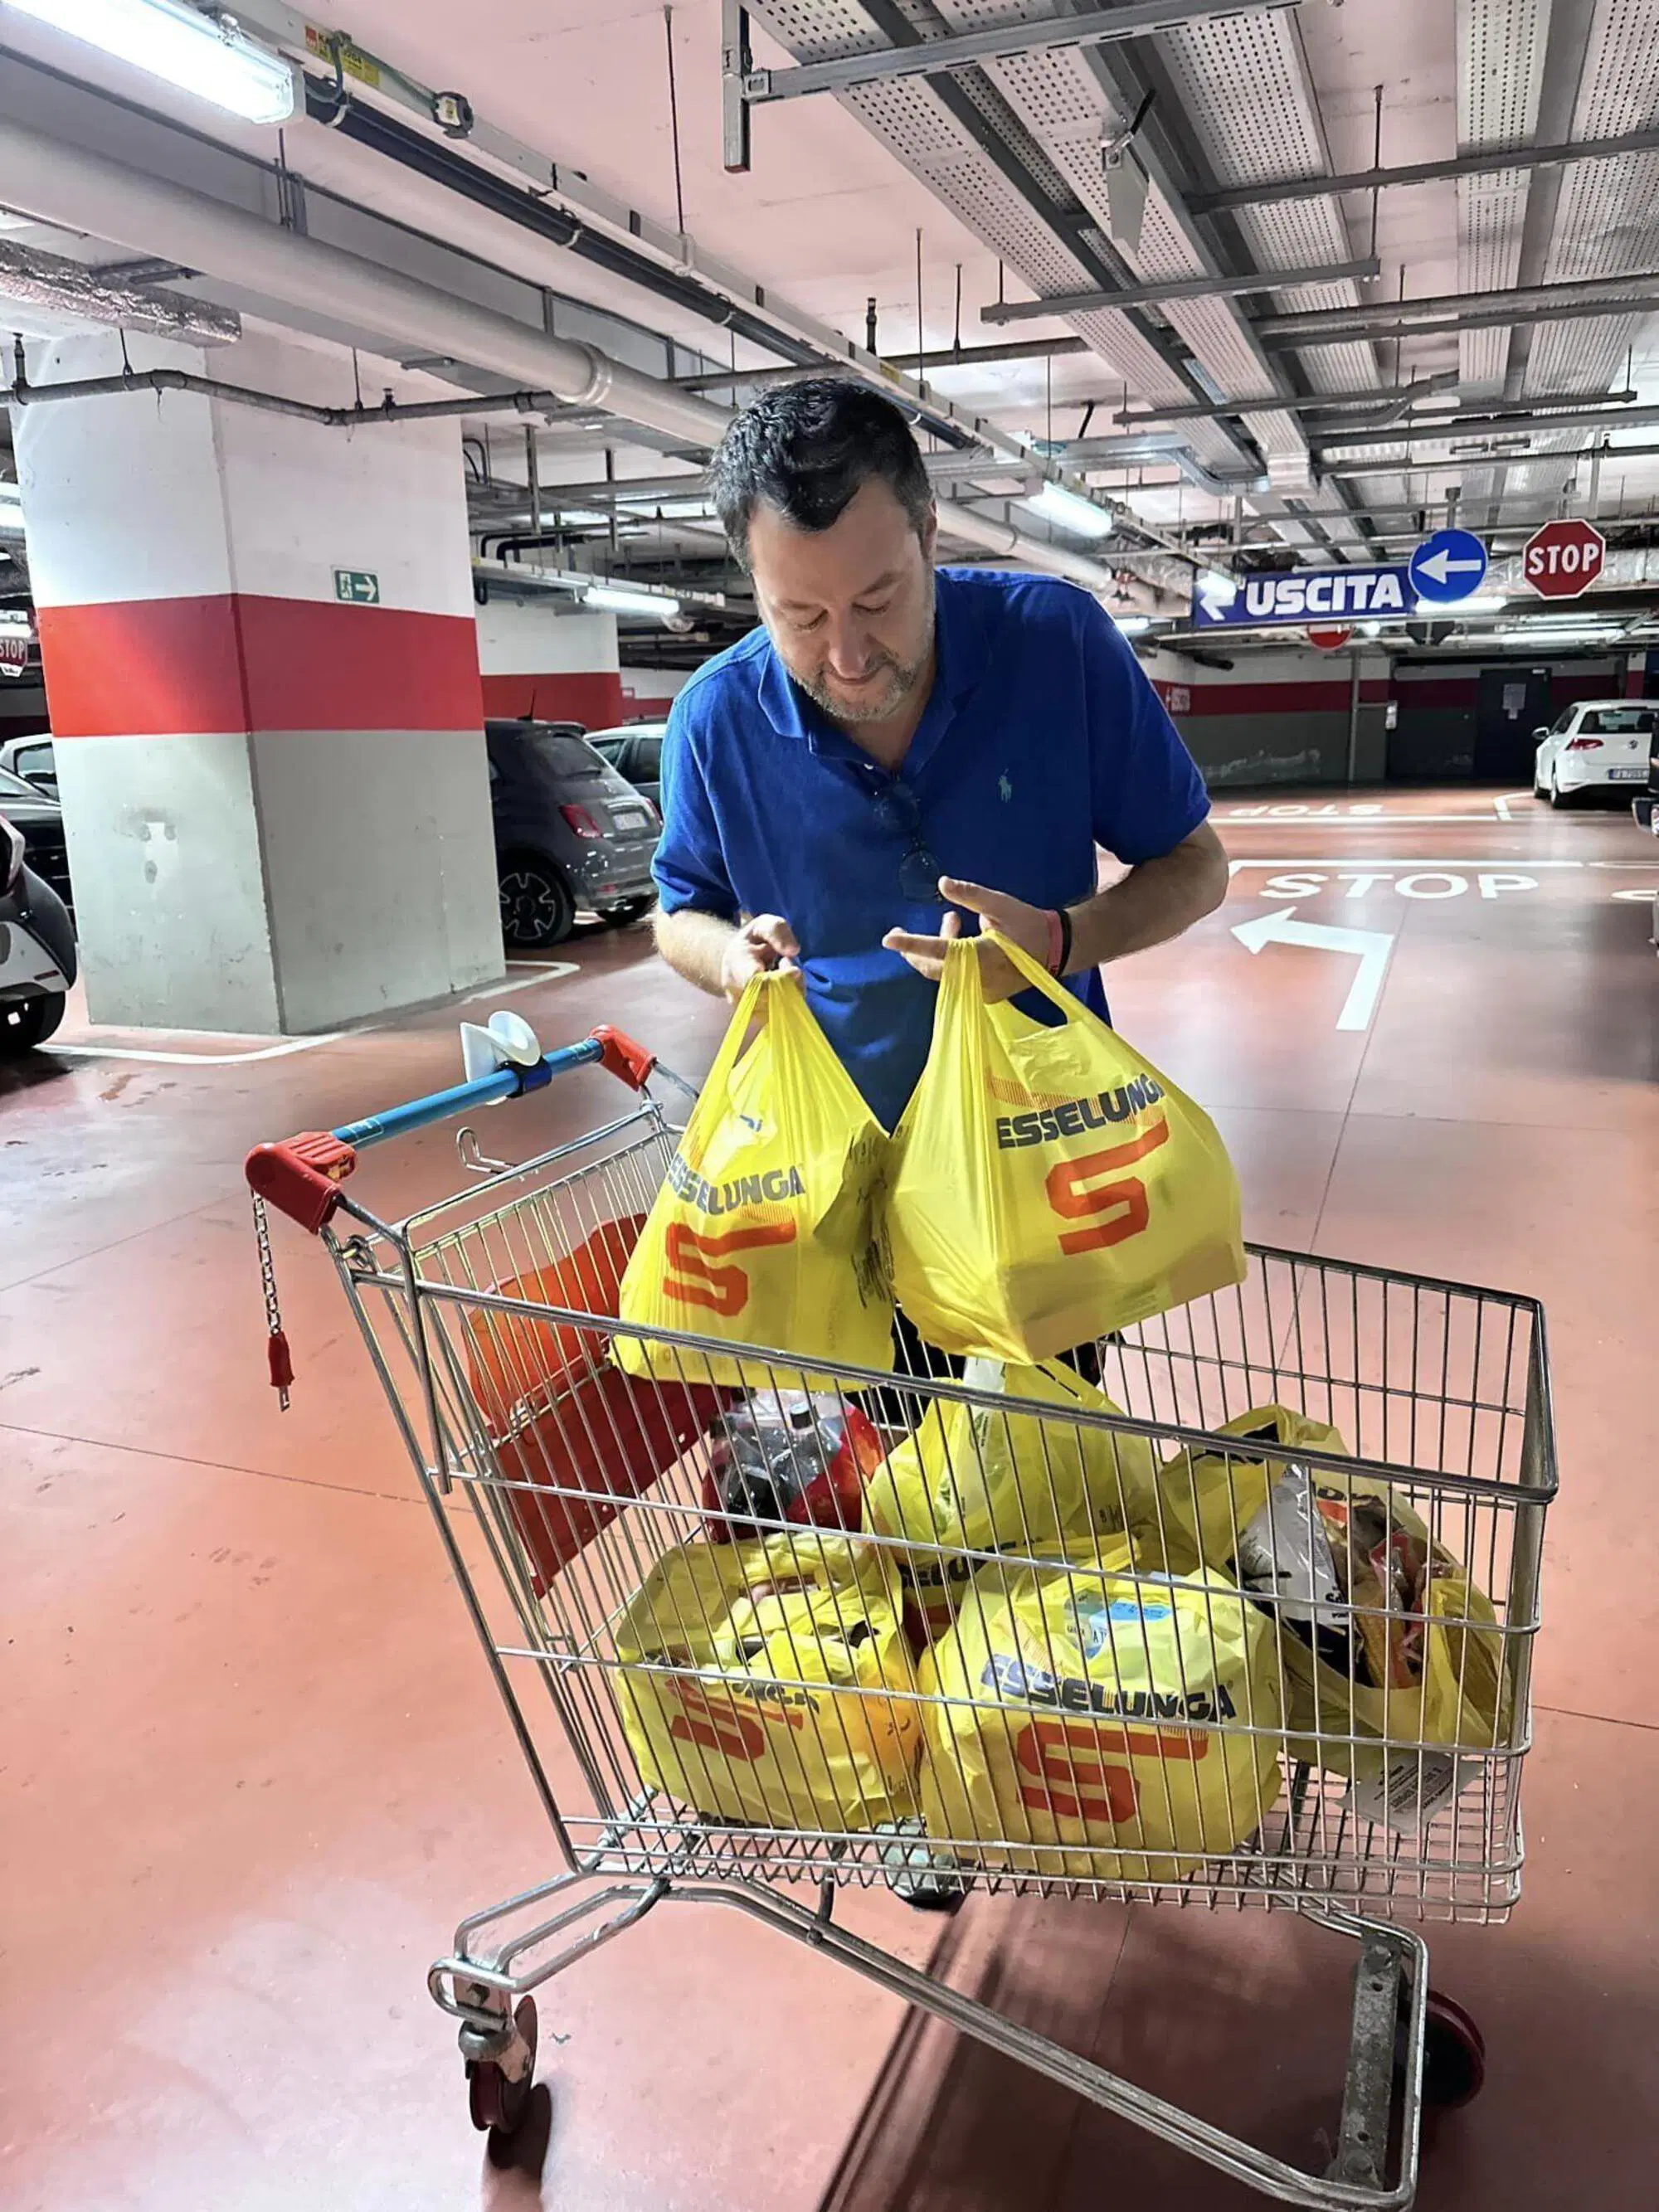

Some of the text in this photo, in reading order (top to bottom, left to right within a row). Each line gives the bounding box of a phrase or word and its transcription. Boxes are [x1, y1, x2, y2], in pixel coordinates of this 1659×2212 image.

[1528, 542, 1599, 576] STOP
[1245, 573, 1404, 616] USCITA
[0, 638, 26, 660] STOP
[1259, 873, 1540, 900] STOP
[667, 1152, 806, 1216] ESSELUNGA
[980, 1653, 1237, 1723] ESSELUNGA
